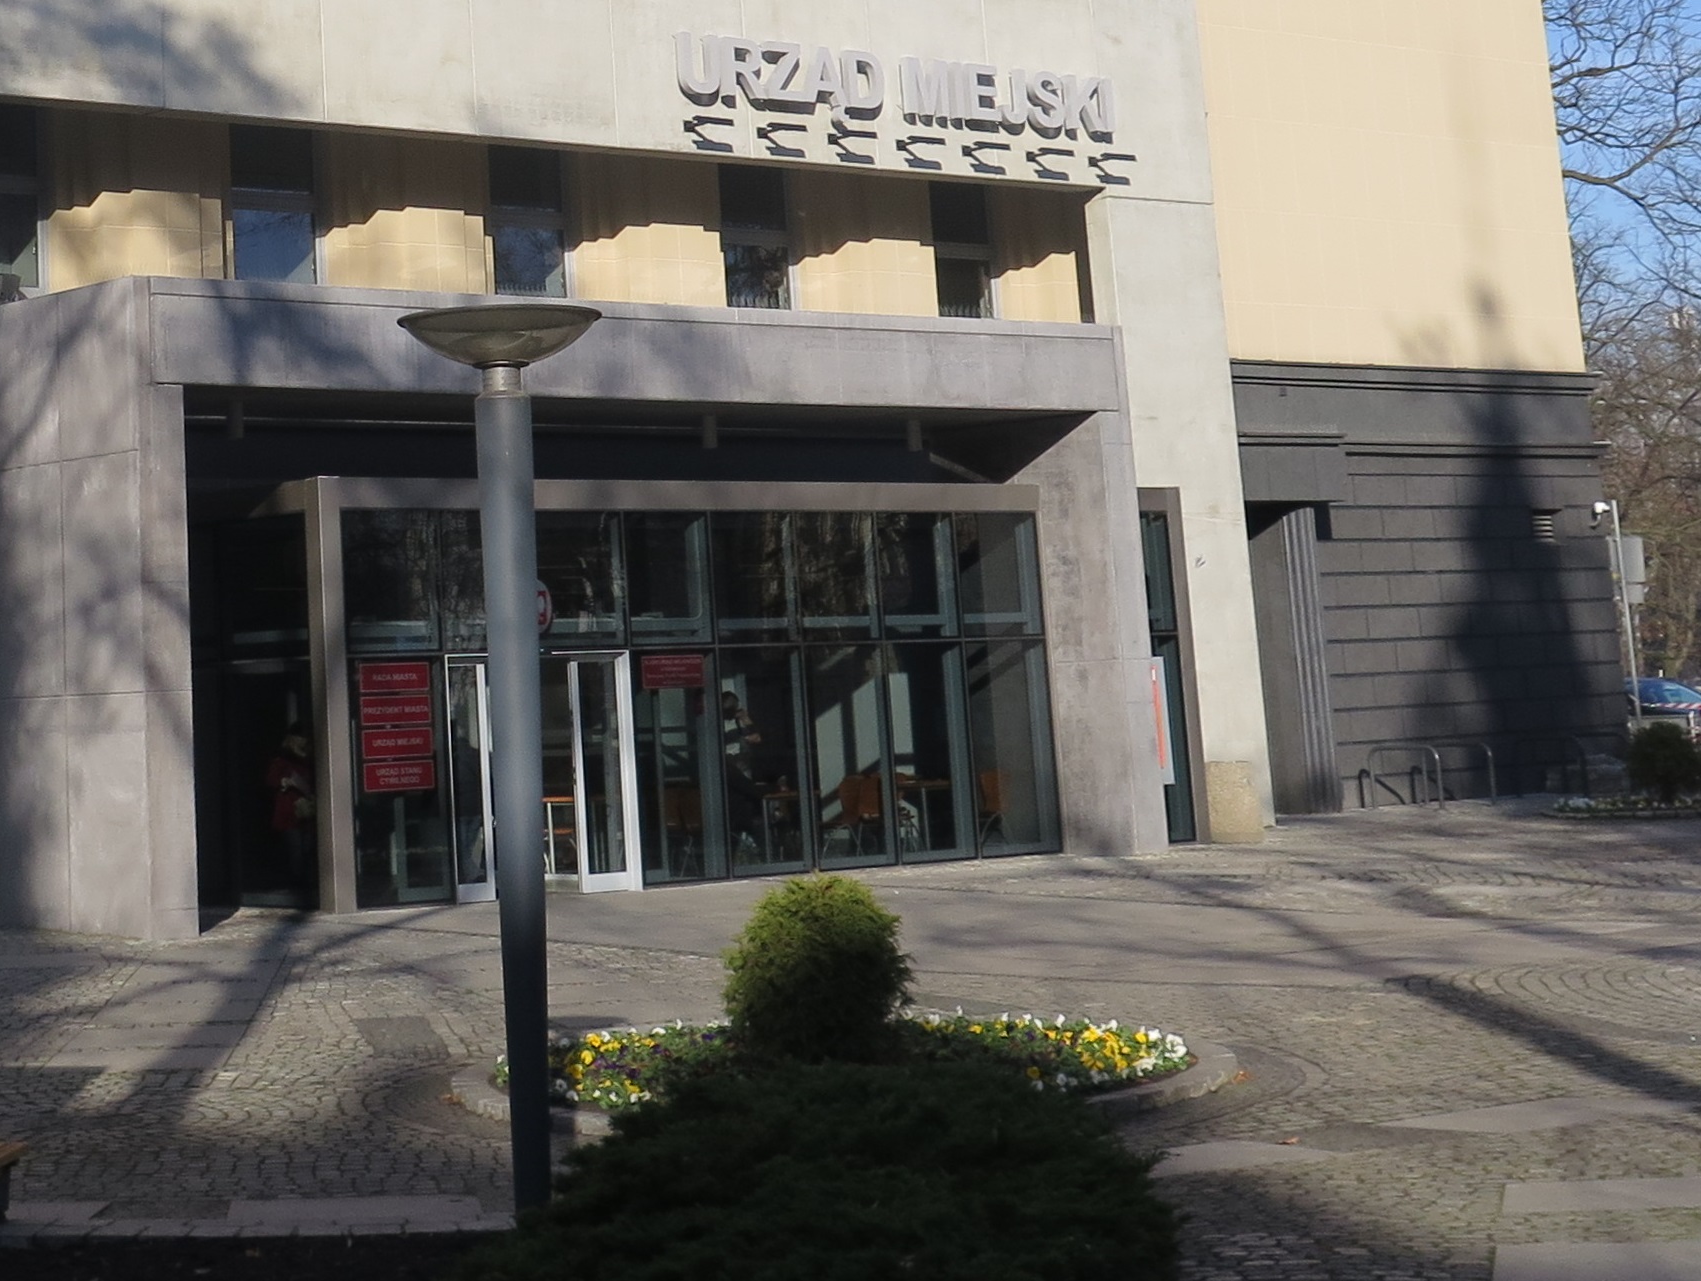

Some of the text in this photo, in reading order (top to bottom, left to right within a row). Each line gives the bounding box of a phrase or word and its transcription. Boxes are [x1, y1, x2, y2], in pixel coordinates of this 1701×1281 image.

[673, 31, 1116, 144] URZĄD MIEJSKI
[404, 705, 429, 713] MIASTA
